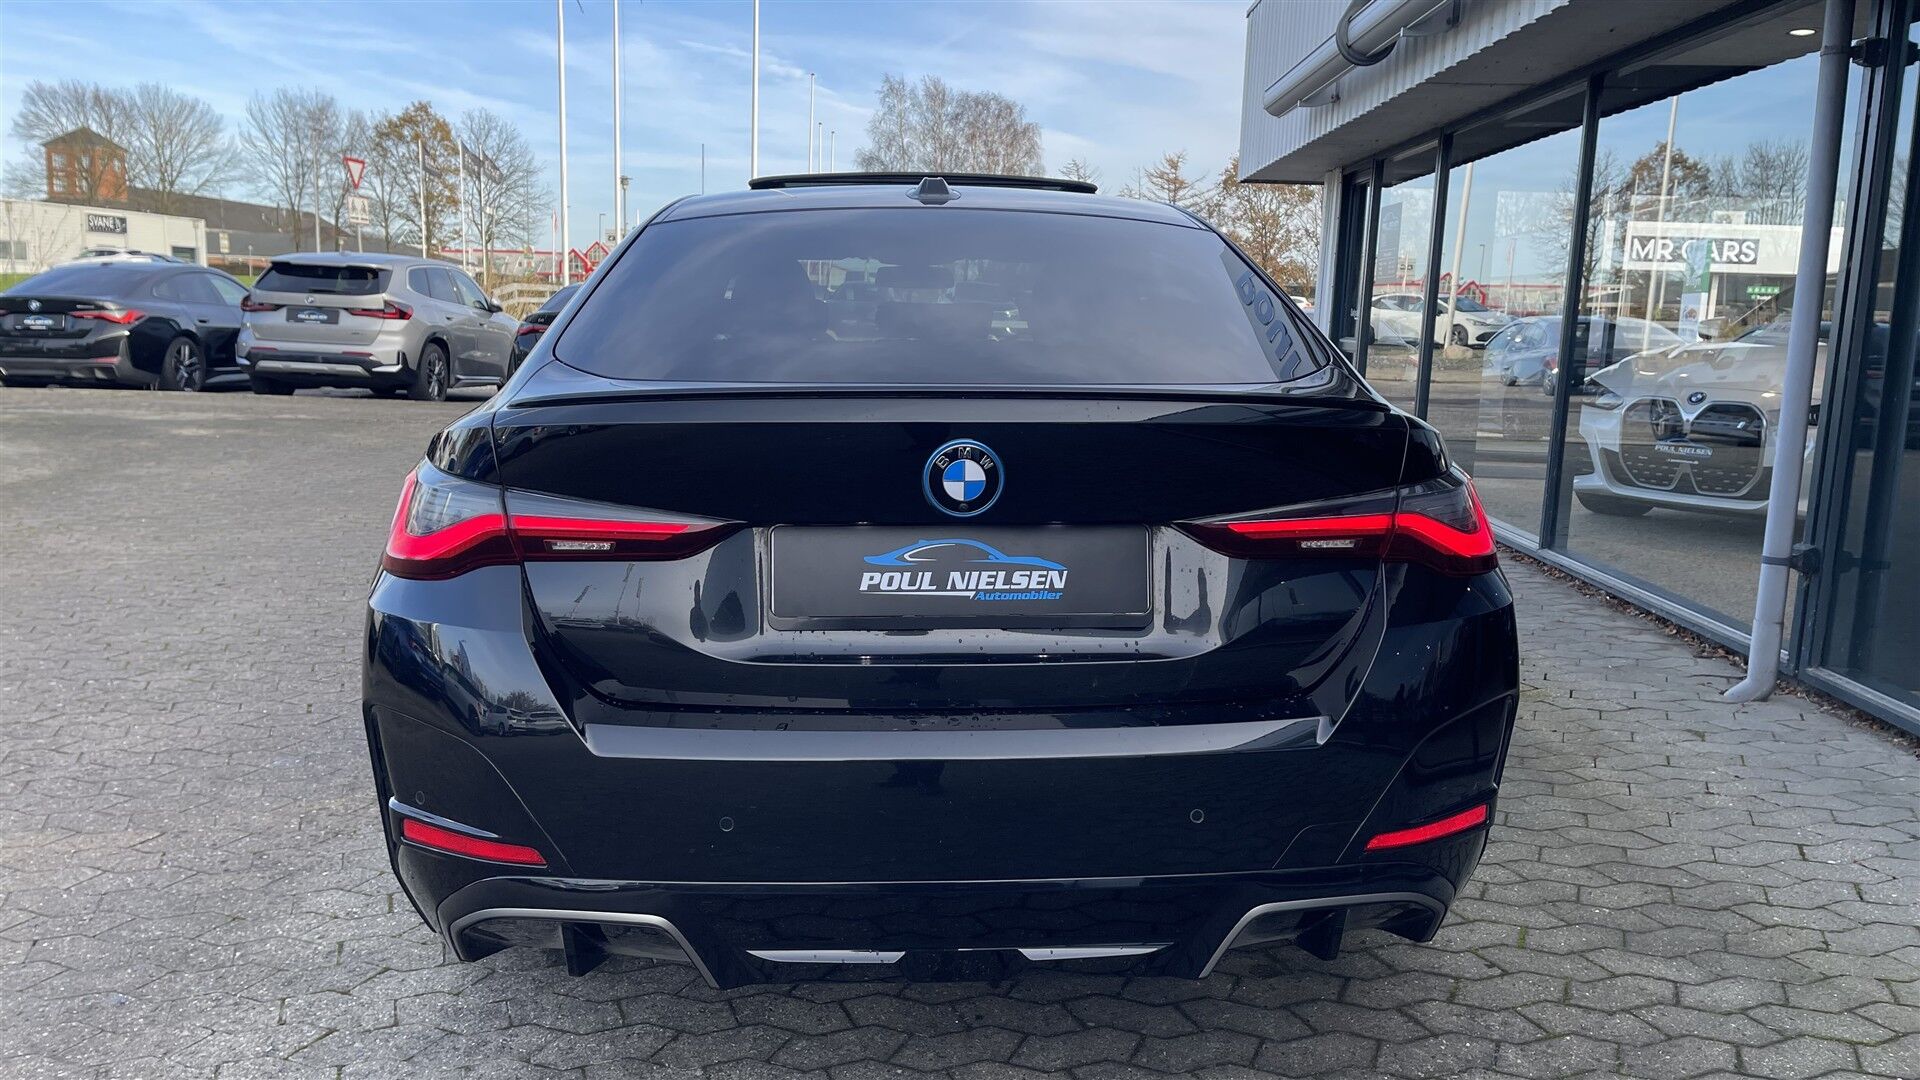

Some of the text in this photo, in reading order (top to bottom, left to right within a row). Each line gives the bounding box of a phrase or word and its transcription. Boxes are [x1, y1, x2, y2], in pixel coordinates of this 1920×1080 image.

[1632, 238, 1674, 260] MR
[935, 446, 995, 470] BMW
[859, 570, 1068, 591] POUL NIELSEN
[974, 590, 1063, 601] Automobiler
